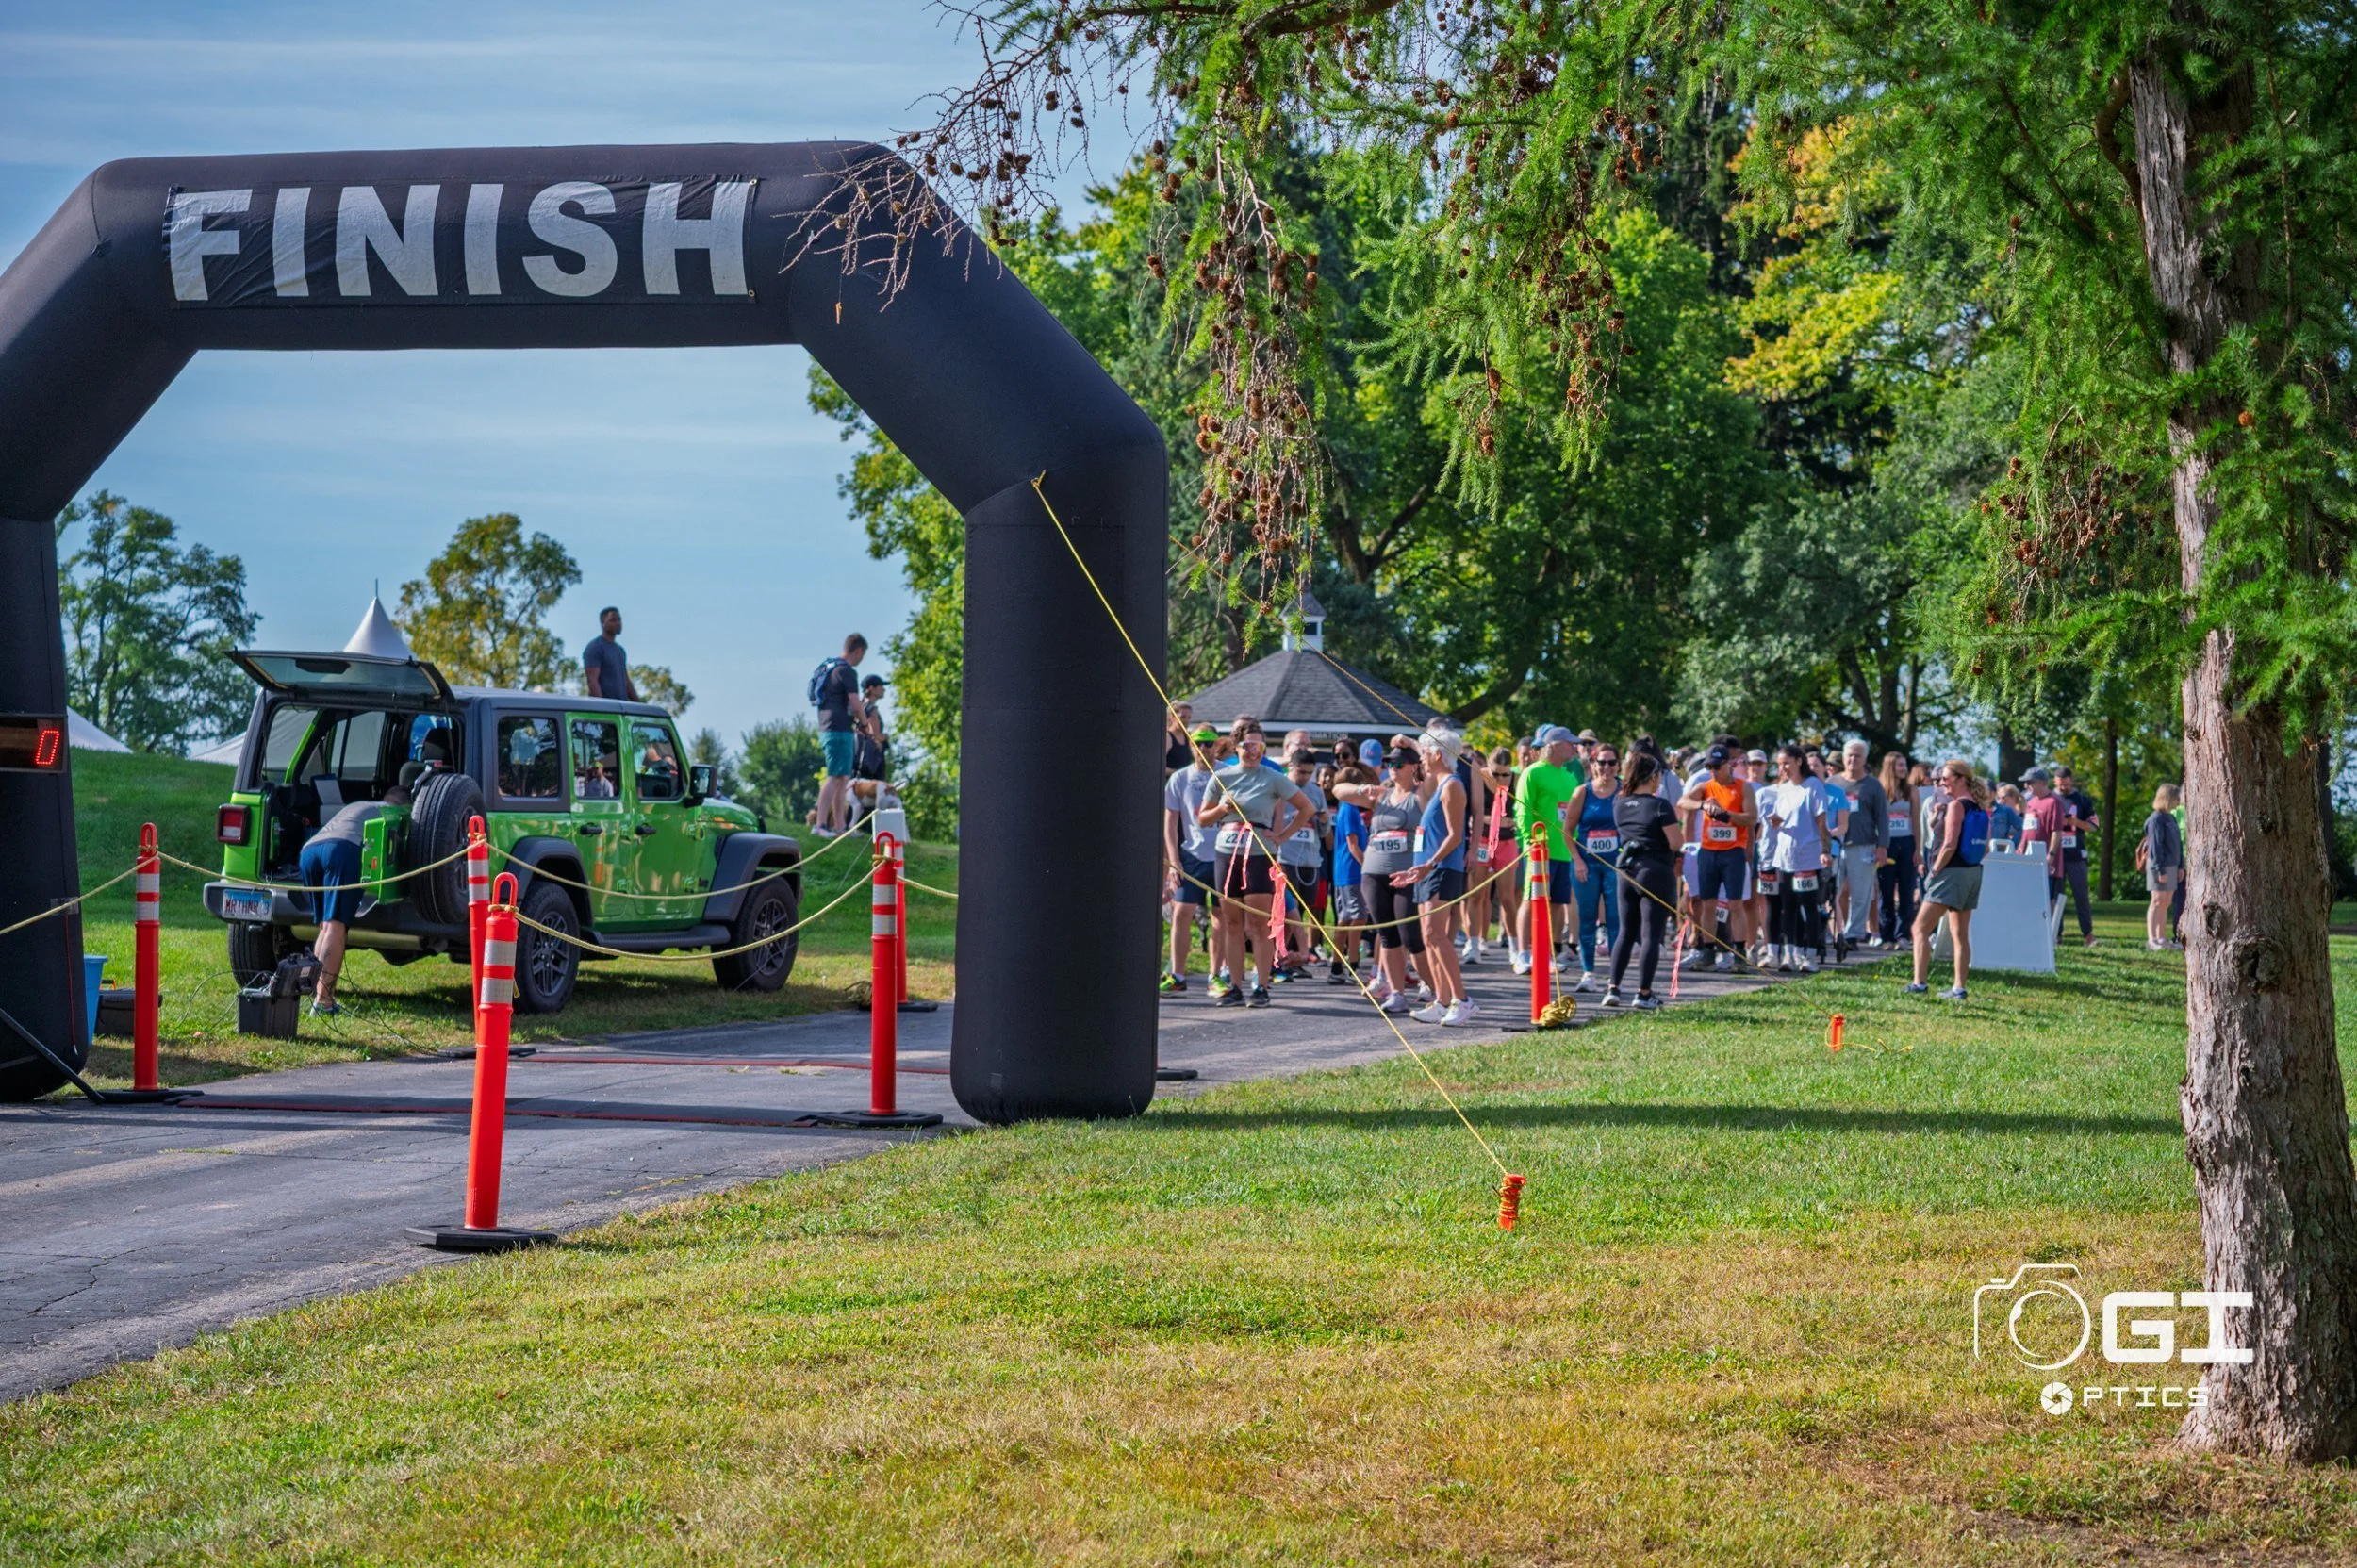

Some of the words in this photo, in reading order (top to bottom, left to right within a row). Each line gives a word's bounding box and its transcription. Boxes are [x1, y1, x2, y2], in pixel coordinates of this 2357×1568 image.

[168, 180, 750, 302] FINISH
[36, 730, 60, 765] 0
[1712, 829, 1732, 839] 399
[1379, 839, 1401, 850] 195
[1591, 840, 1612, 850] 400
